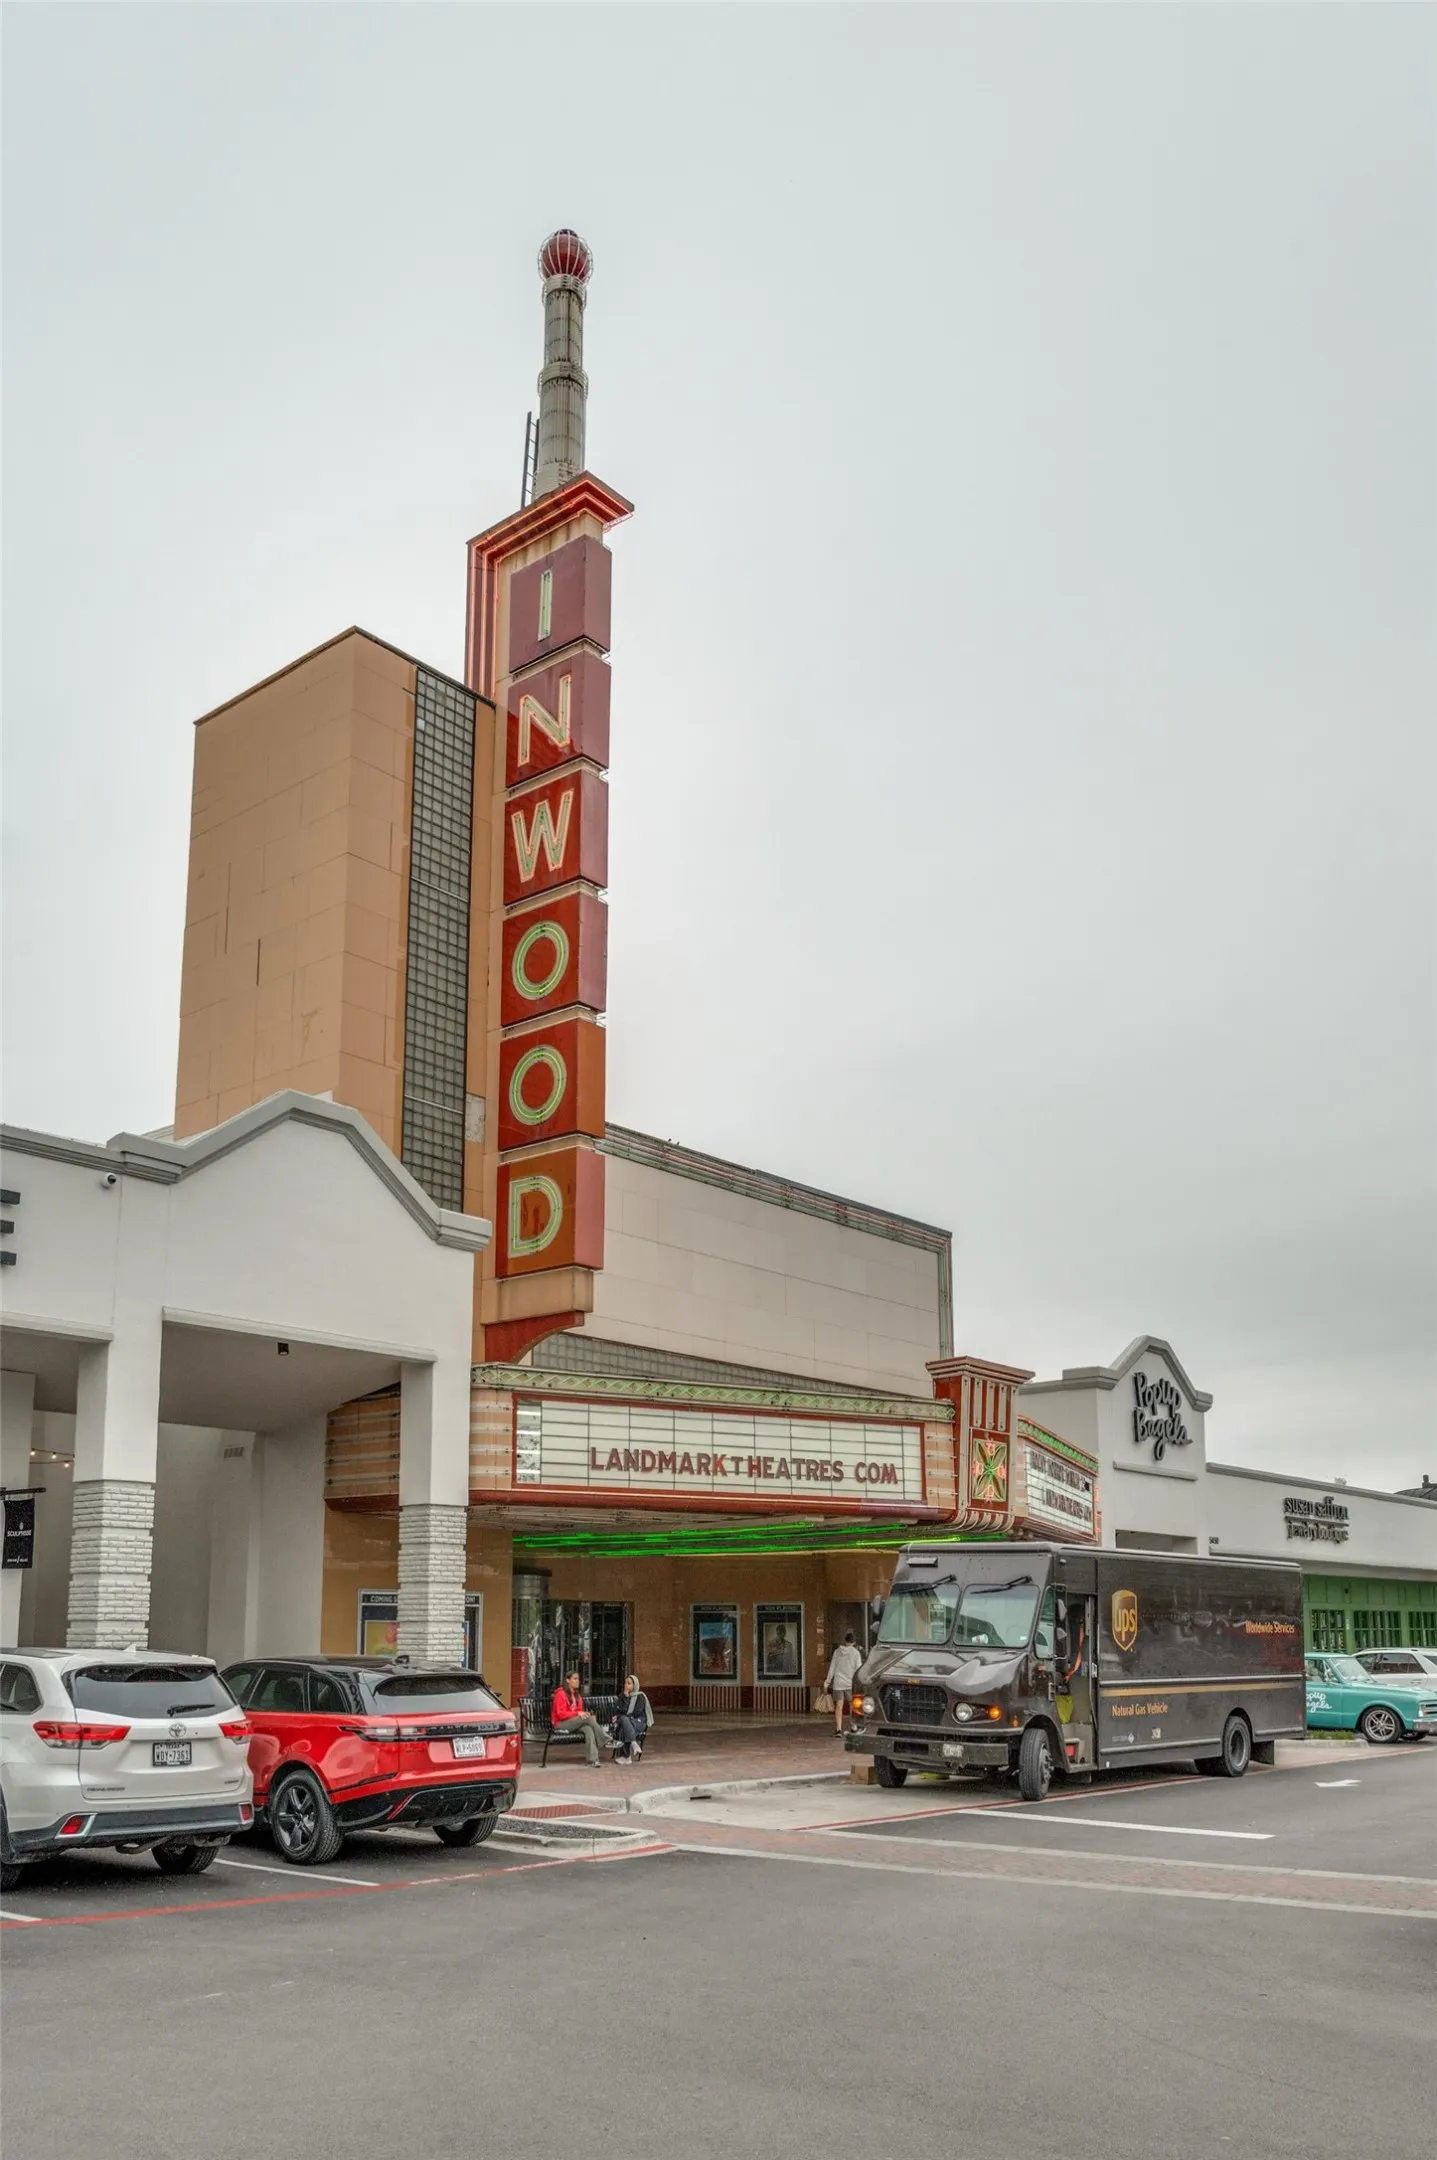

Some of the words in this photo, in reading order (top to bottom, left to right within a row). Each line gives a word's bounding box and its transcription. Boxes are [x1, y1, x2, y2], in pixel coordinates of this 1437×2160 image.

[507, 568, 574, 1259] INWOOD
[1133, 1406, 1193, 1461] Bagels
[854, 1461, 899, 1485] COM
[370, 1595, 395, 1603] COMING
[1114, 1608, 1136, 1641] ups
[1245, 1620, 1274, 1634] Worldwide
[1274, 1620, 1295, 1634] Services
[1112, 1703, 1135, 1717] Natural
[1135, 1703, 1147, 1716] Gas
[1147, 1702, 1168, 1715] Vehicle
